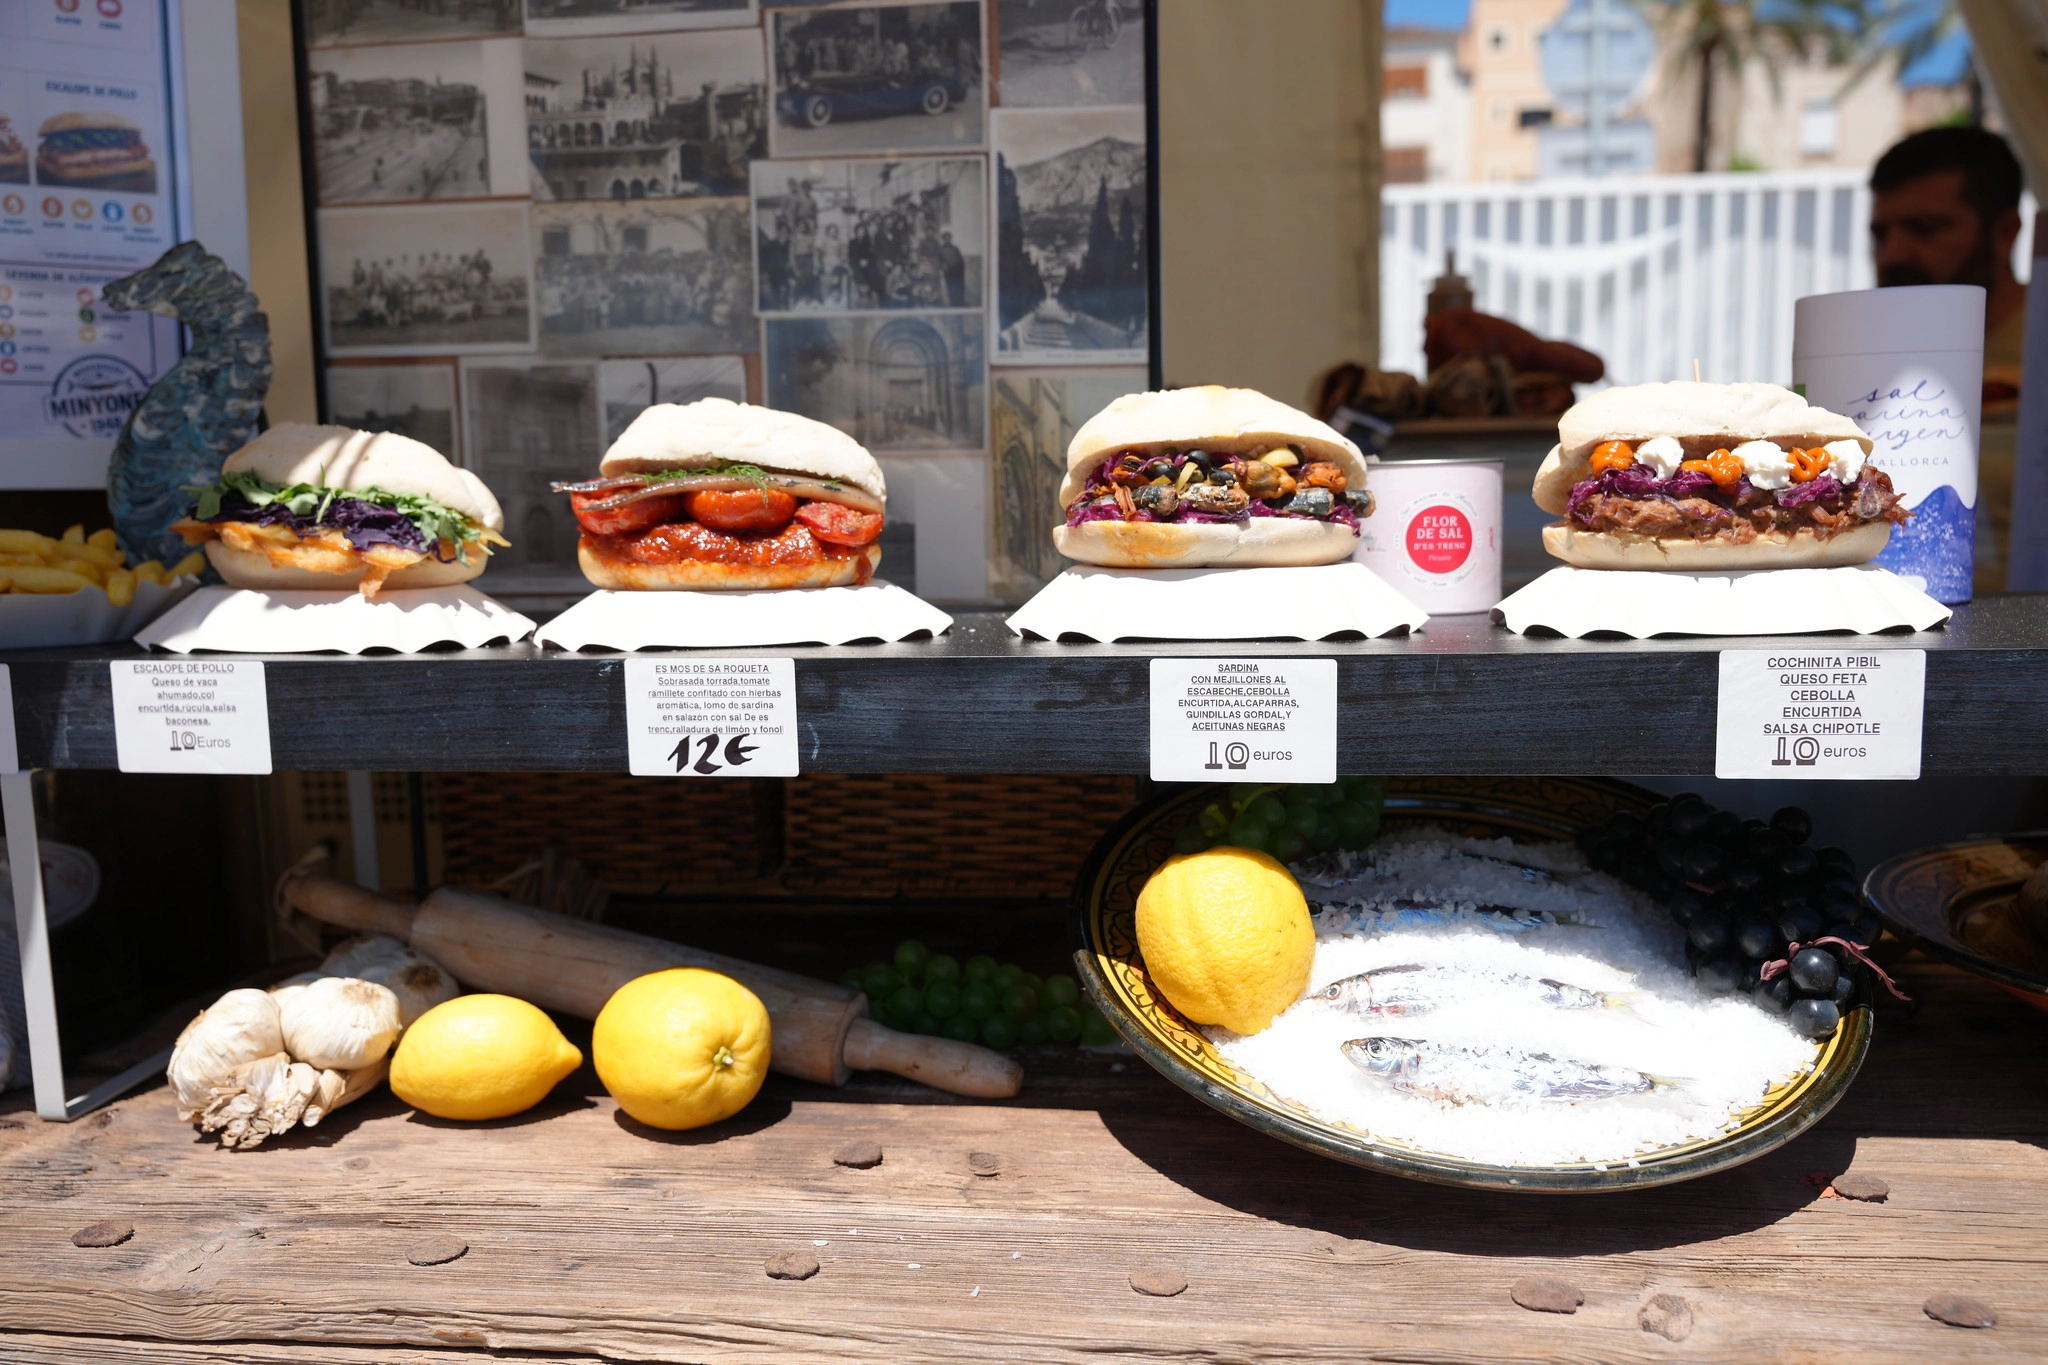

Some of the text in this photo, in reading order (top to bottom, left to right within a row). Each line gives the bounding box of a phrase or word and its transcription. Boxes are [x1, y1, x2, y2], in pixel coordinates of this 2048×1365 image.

[1847, 380, 1944, 405] sal
[1843, 405, 1966, 421] arina
[1867, 425, 1964, 450] irgen
[1865, 457, 1949, 467] MALLORCA
[1423, 516, 1458, 527] FLOR
[1416, 527, 1464, 539] DE SAL
[1437, 542, 1466, 550] TRENC
[1767, 656, 1881, 668] COCHINITA PIBIL
[133, 664, 235, 673] ESCALOPE DE POLLO
[655, 665, 770, 673] ES MOS DE SA ROQUETA
[1217, 664, 1259, 672] SARDINA
[152, 678, 181, 687] Queso
[184, 678, 194, 686] de
[658, 677, 770, 686] Sobrasada torrada,tomate
[1191, 676, 1286, 684] CON MEJILLONES AL
[1780, 673, 1867, 685] QUESO FETA
[648, 689, 685, 697] ramillete
[687, 689, 728, 697] confitado
[749, 689, 782, 697] hierbas
[1187, 688, 1290, 697] ESCABECHE,CEBOLLA
[1790, 690, 1855, 701] CEBOLLA
[704, 701, 726, 709] lomo
[728, 701, 739, 709] de
[741, 701, 774, 709] sardina
[1178, 699, 1300, 708] ENCURTIDA,ALCAPARRAS,
[729, 713, 742, 721] sal
[744, 713, 756, 721] De
[1186, 711, 1241, 719] GUINDILLAS
[1783, 707, 1862, 718] ENCURTIDA
[648, 725, 711, 734] trenc,ralladura
[712, 725, 724, 733] de
[725, 725, 750, 733] limón
[752, 727, 758, 735] y
[1192, 722, 1285, 730] ACEITUNAS NEGRAS
[1763, 723, 1881, 734] SALSA CHIPOTLE
[170, 730, 231, 751] 10 Euros
[667, 733, 760, 775] 12€
[1204, 741, 1293, 770] 10 euros
[1772, 737, 1867, 765] 10 euros
